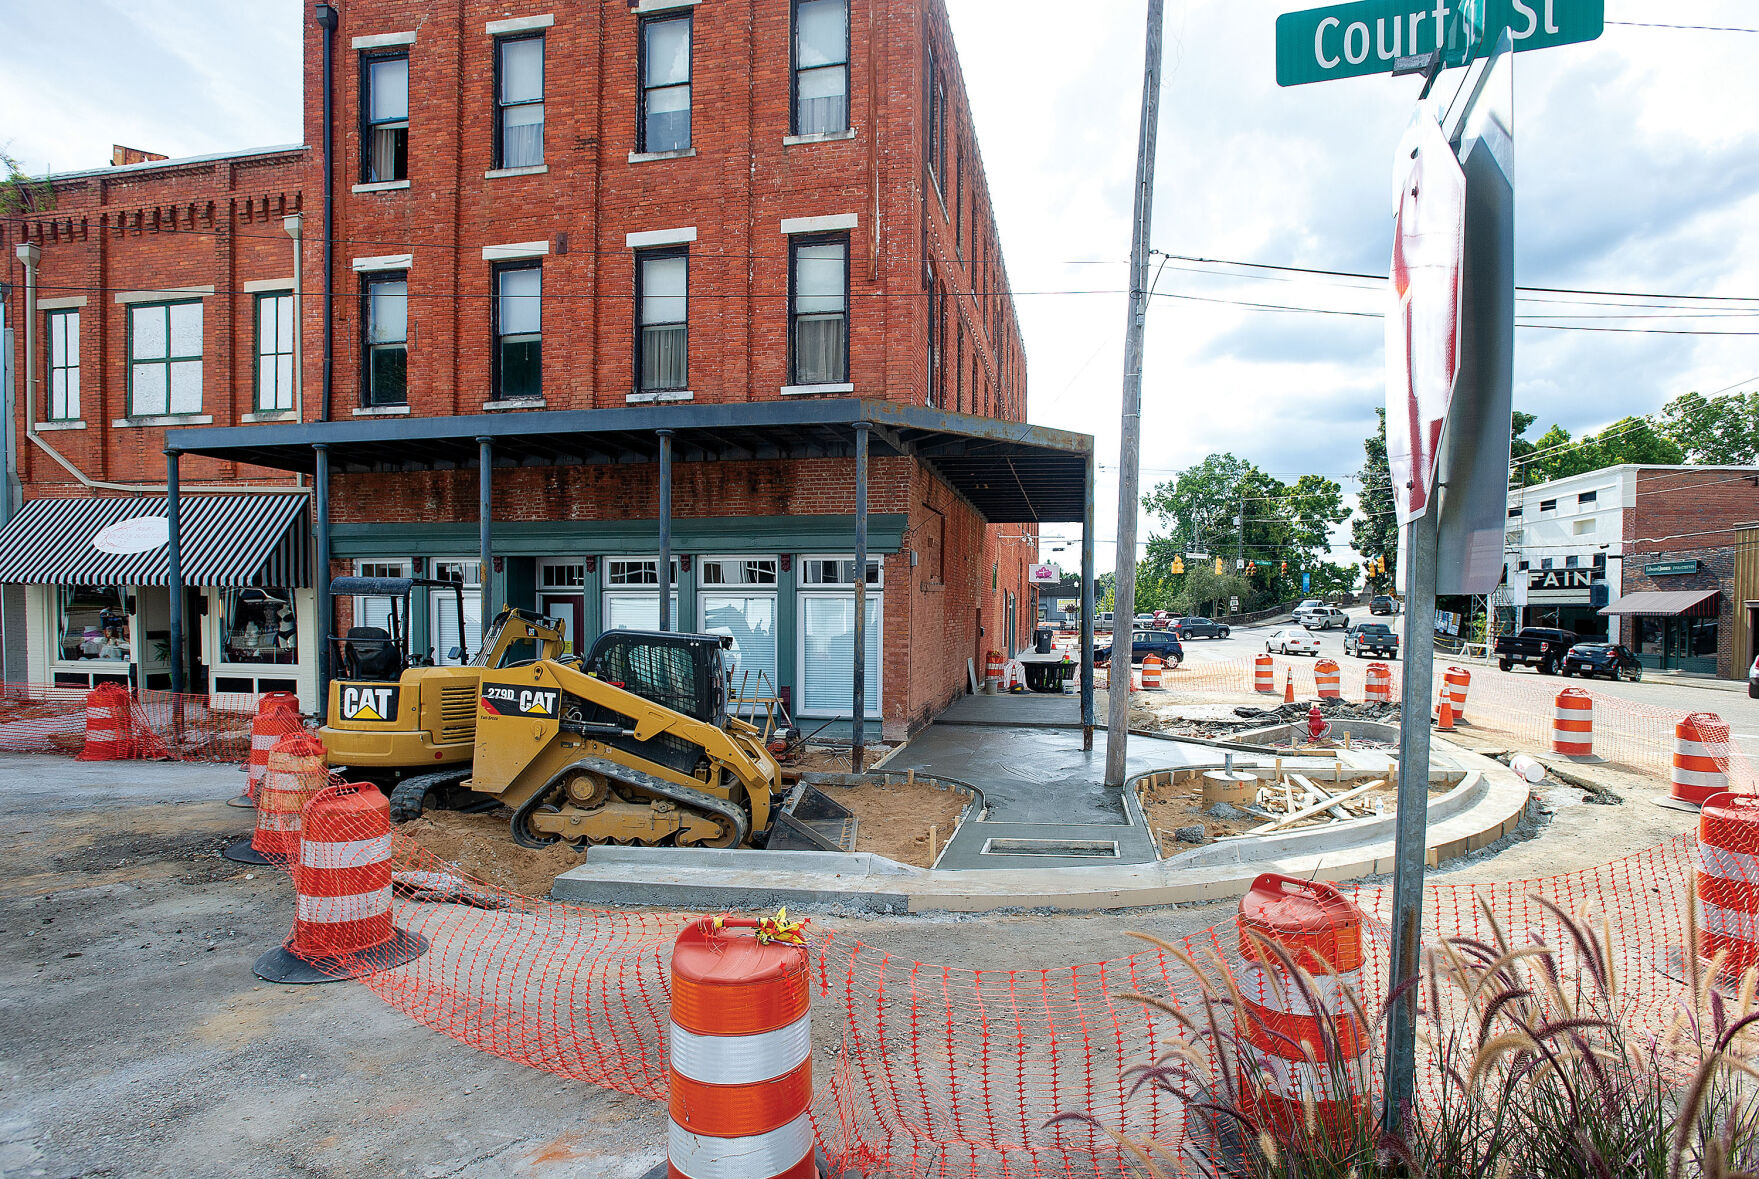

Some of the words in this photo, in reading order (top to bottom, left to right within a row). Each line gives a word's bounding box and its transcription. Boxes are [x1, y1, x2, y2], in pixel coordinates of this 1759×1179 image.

[1314, 0, 1450, 69] Court
[1511, 0, 1559, 39] St
[1528, 571, 1592, 587] FAIN
[344, 687, 393, 719] CAT
[487, 687, 515, 701] 279D
[519, 690, 556, 715] CAT
